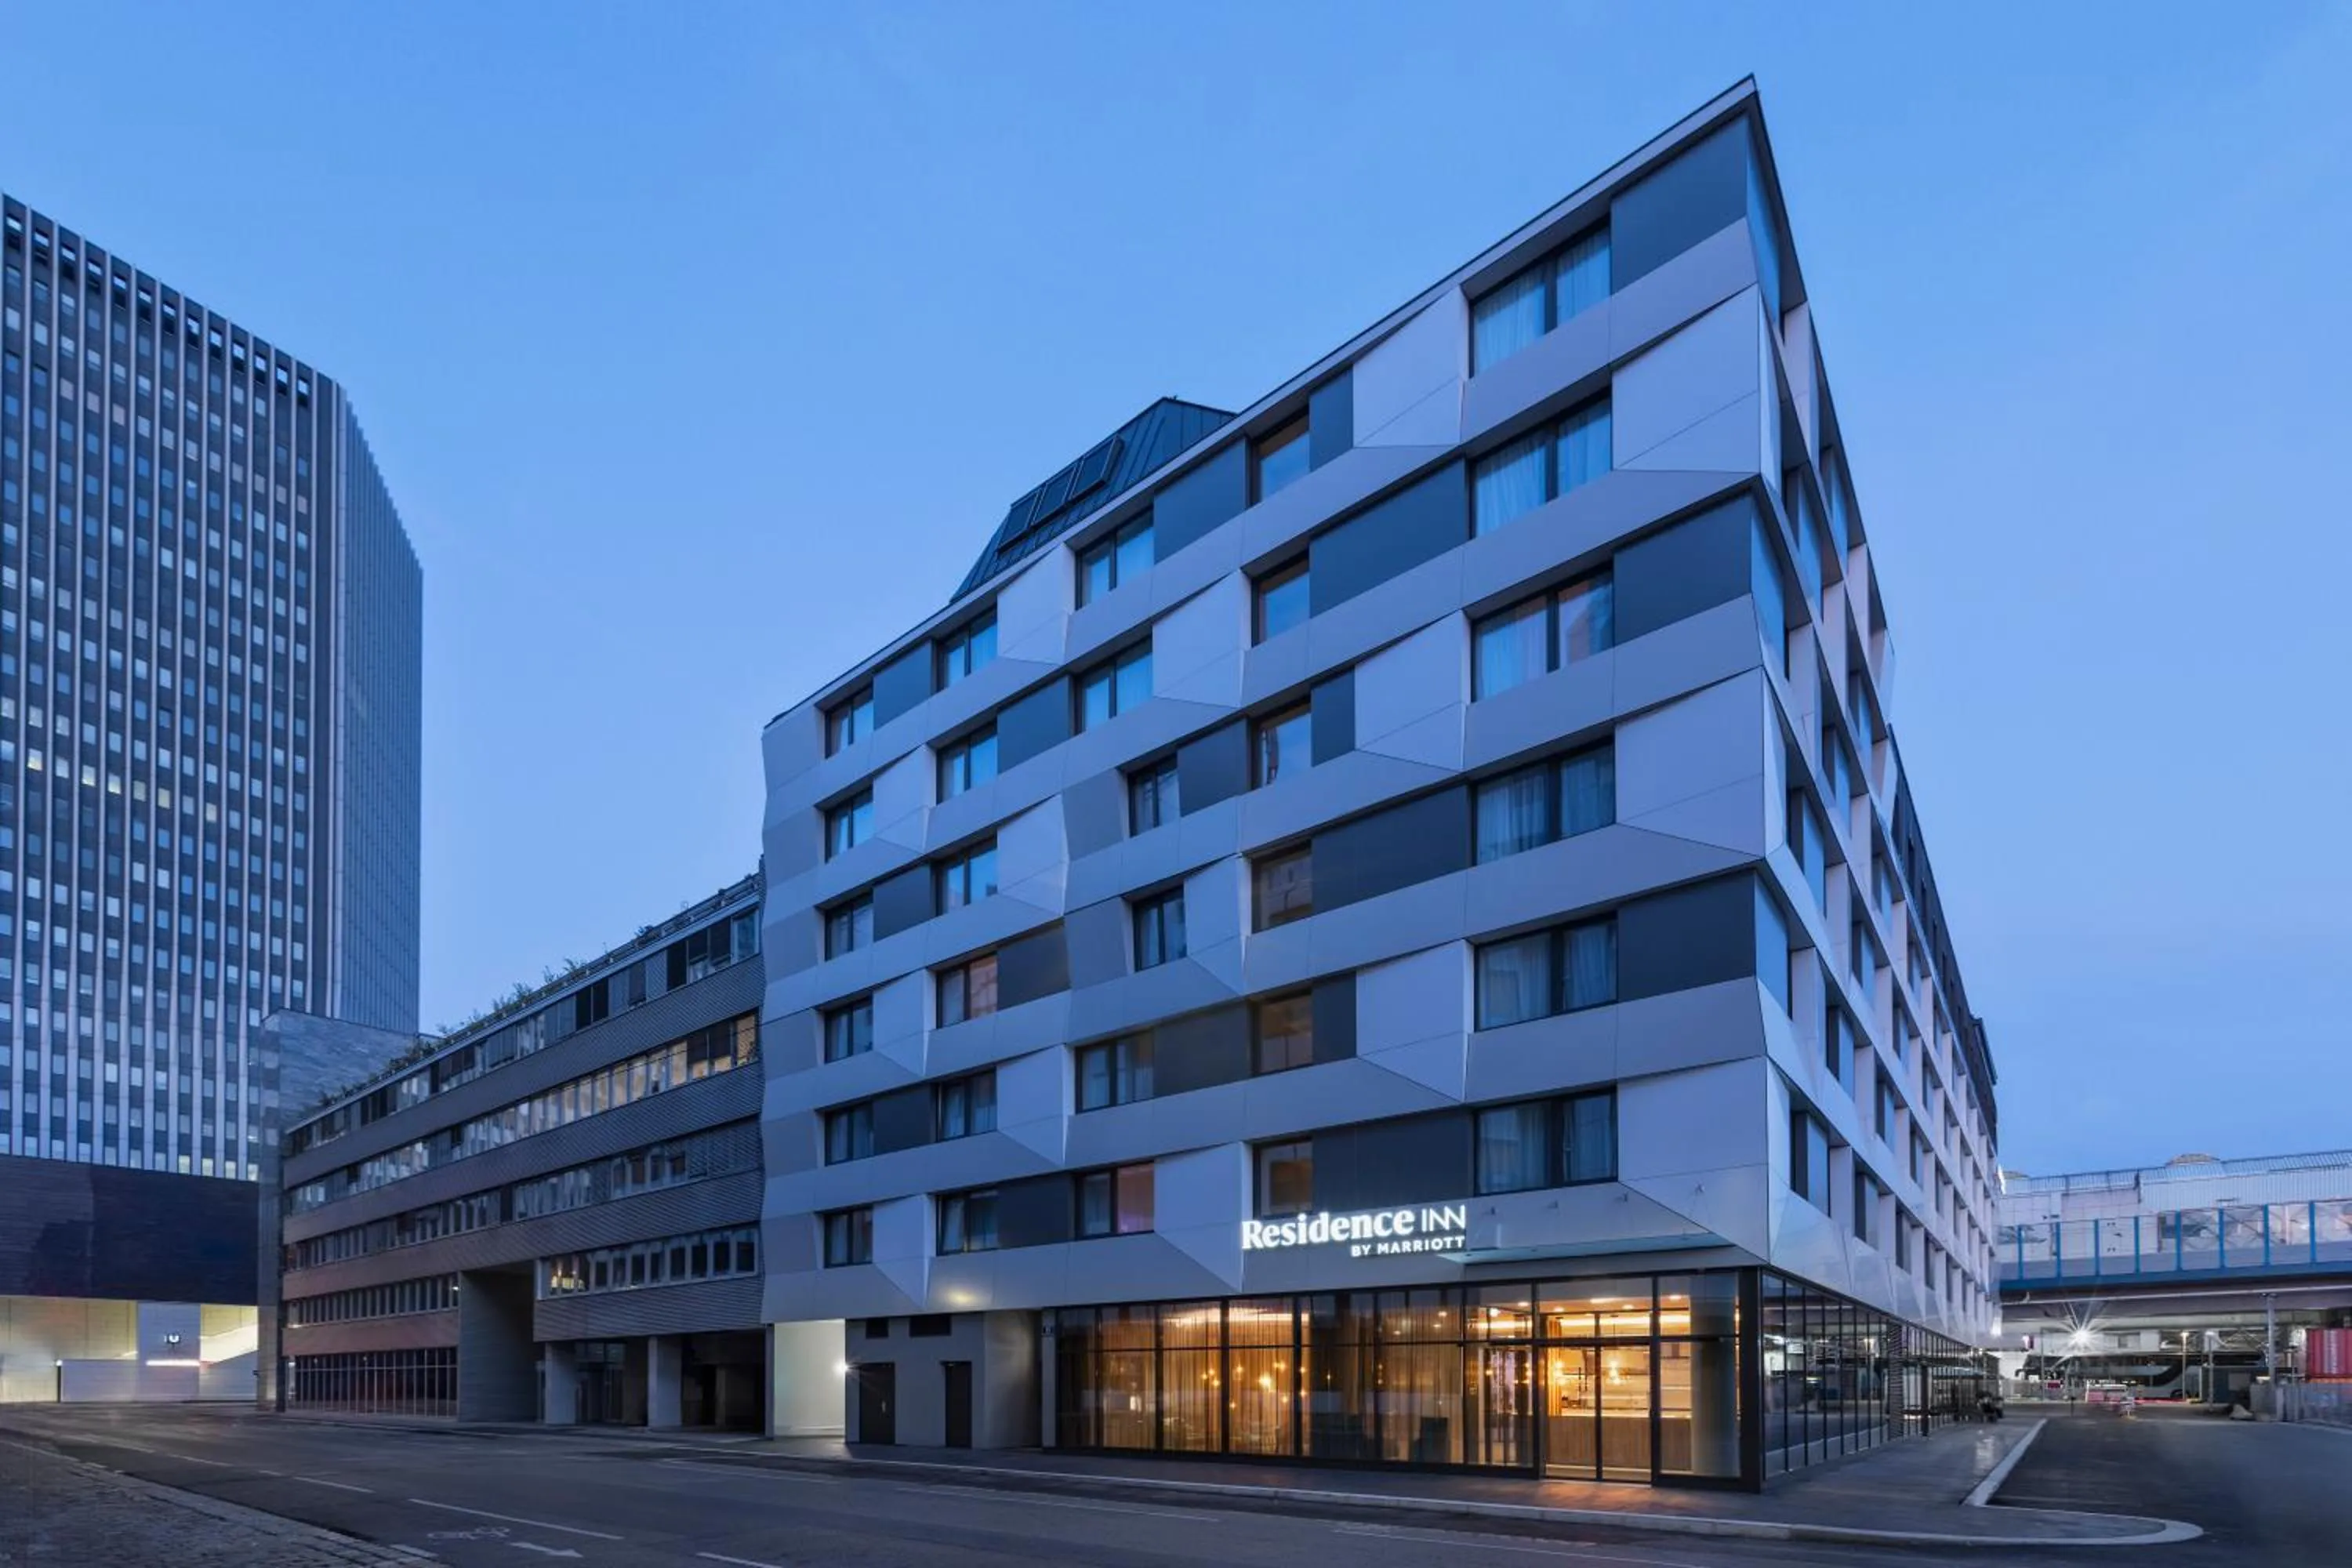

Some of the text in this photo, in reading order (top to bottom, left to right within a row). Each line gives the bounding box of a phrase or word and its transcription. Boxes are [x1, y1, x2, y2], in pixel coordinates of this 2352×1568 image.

[1241, 1205, 1466, 1250] Residence INN
[1351, 1236, 1465, 1258] BY MARRIOTT
